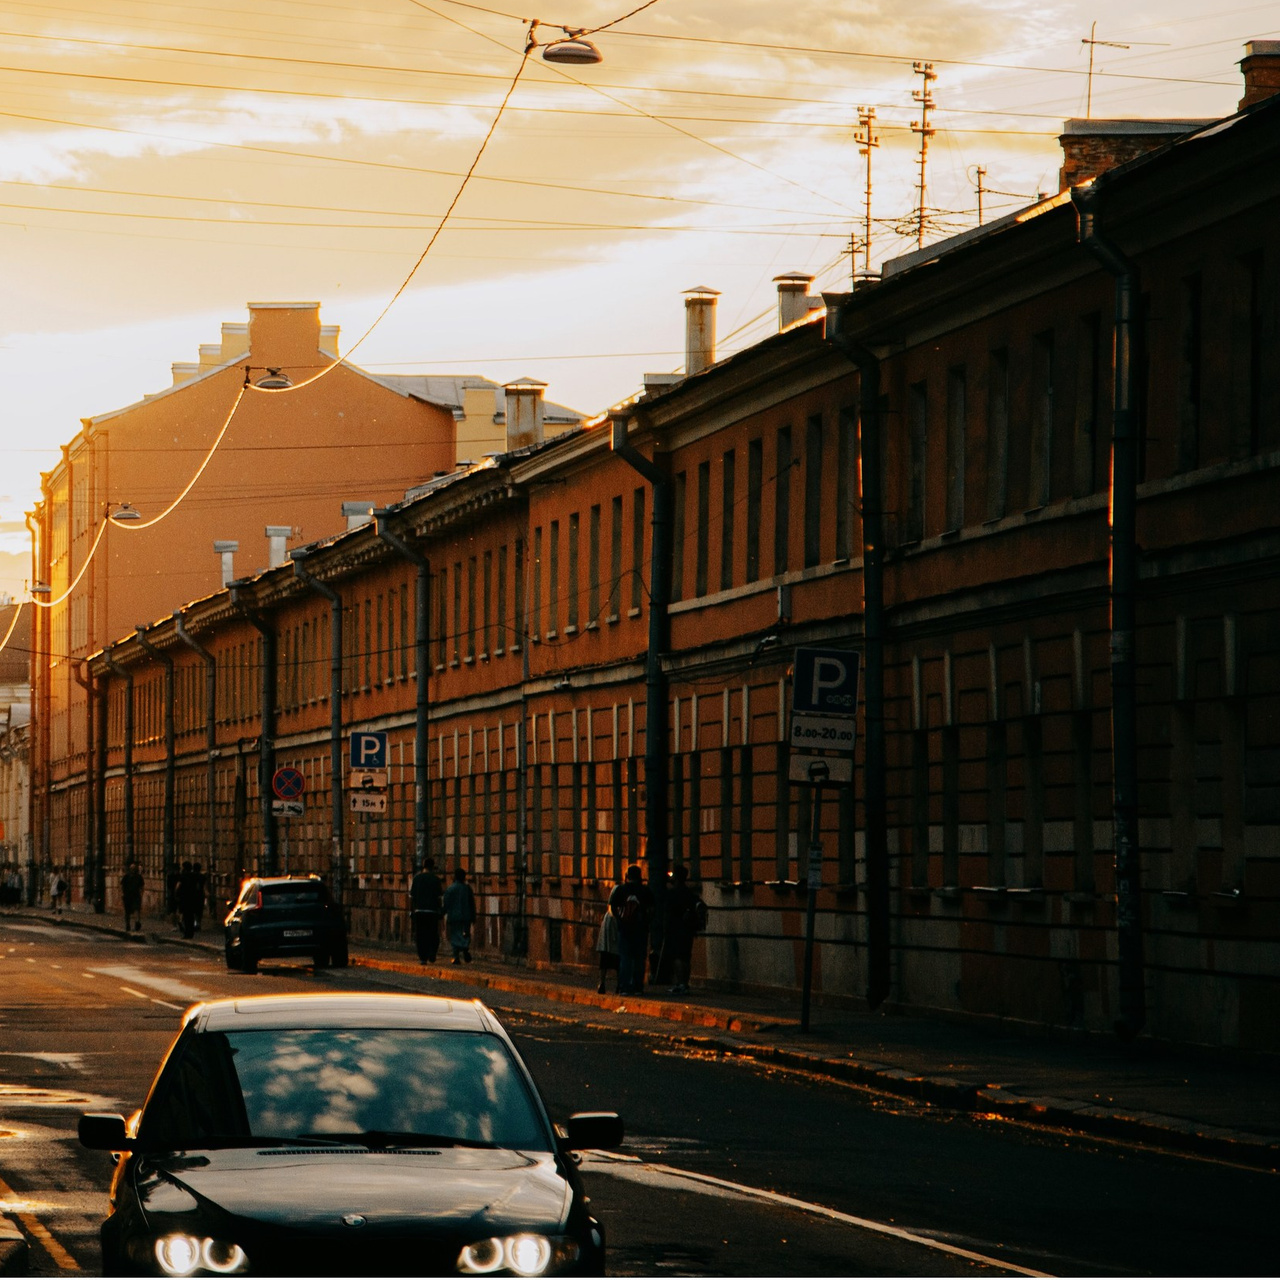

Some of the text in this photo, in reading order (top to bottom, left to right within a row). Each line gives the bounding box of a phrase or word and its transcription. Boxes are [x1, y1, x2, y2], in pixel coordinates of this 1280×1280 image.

[811, 656, 847, 705] P
[794, 725, 852, 741] 8.00-20.00
[360, 735, 380, 764] P
